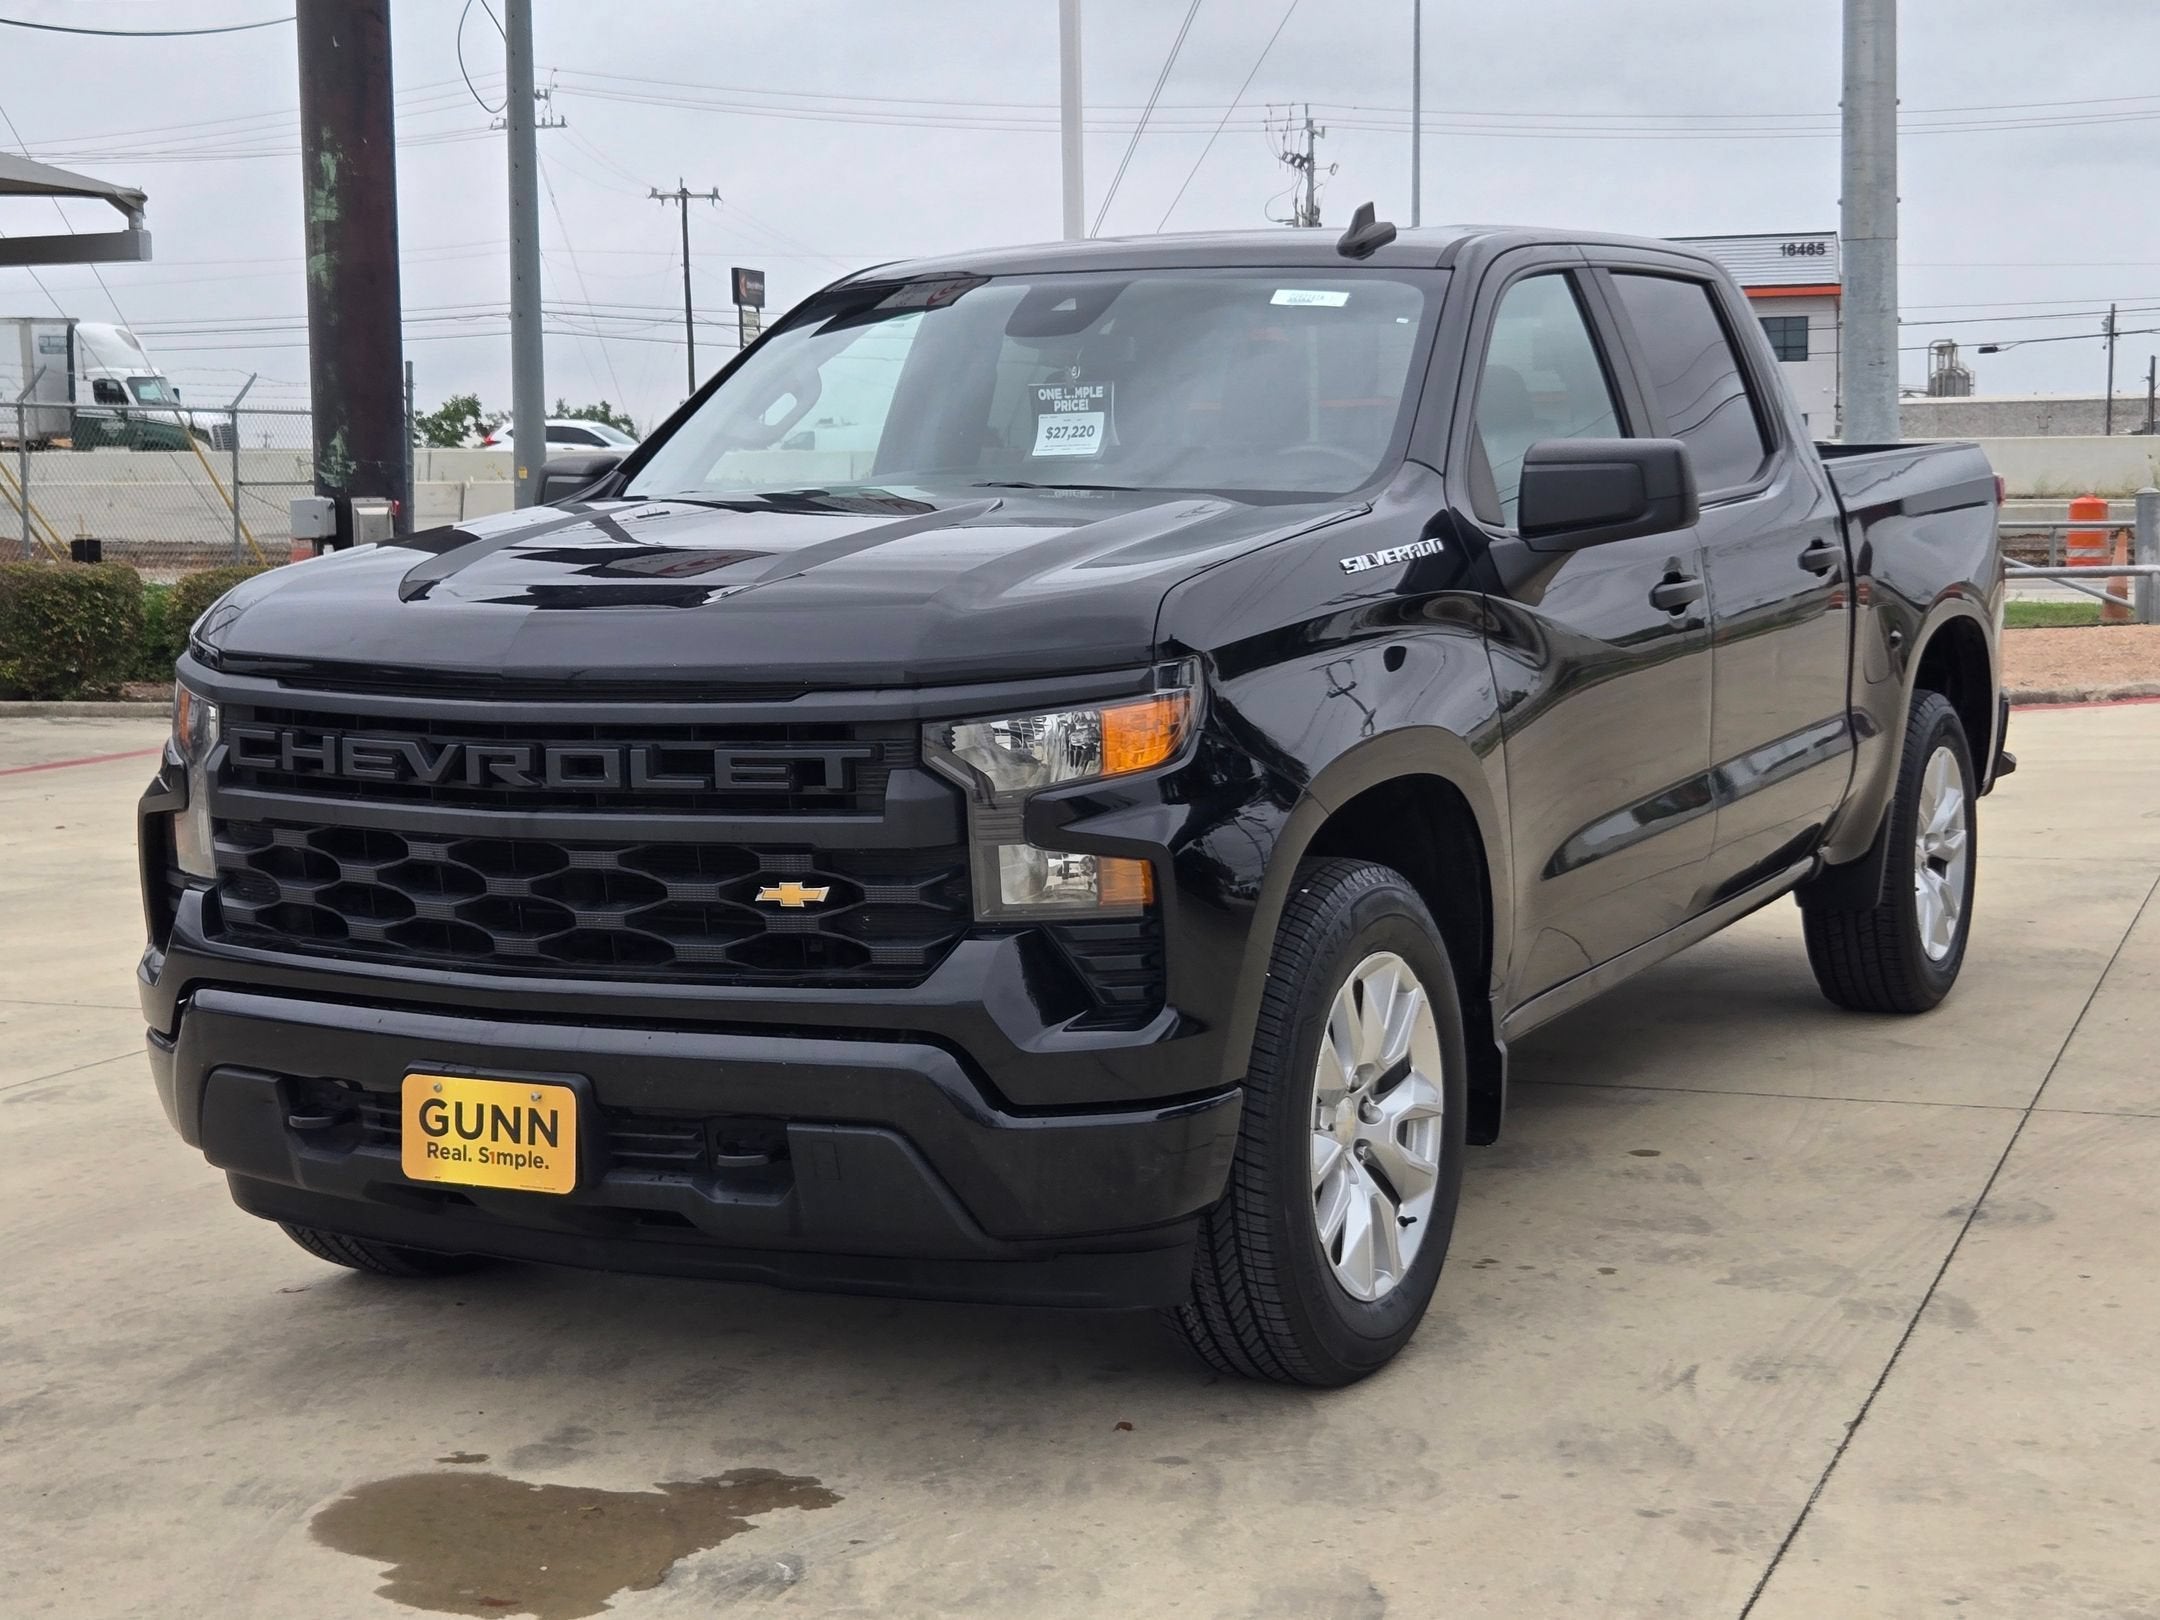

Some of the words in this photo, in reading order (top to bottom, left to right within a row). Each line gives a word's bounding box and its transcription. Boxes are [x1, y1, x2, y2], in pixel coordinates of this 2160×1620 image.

[1780, 242, 1825, 257] 16465
[1038, 388, 1062, 401] ONE
[1064, 386, 1103, 399] MPLE
[1045, 424, 1095, 441] $27,220
[1340, 537, 1444, 575] SILVERADO
[229, 727, 874, 790] CHEVROLET
[419, 1098, 558, 1148] GUNN
[427, 1142, 472, 1163] Real.
